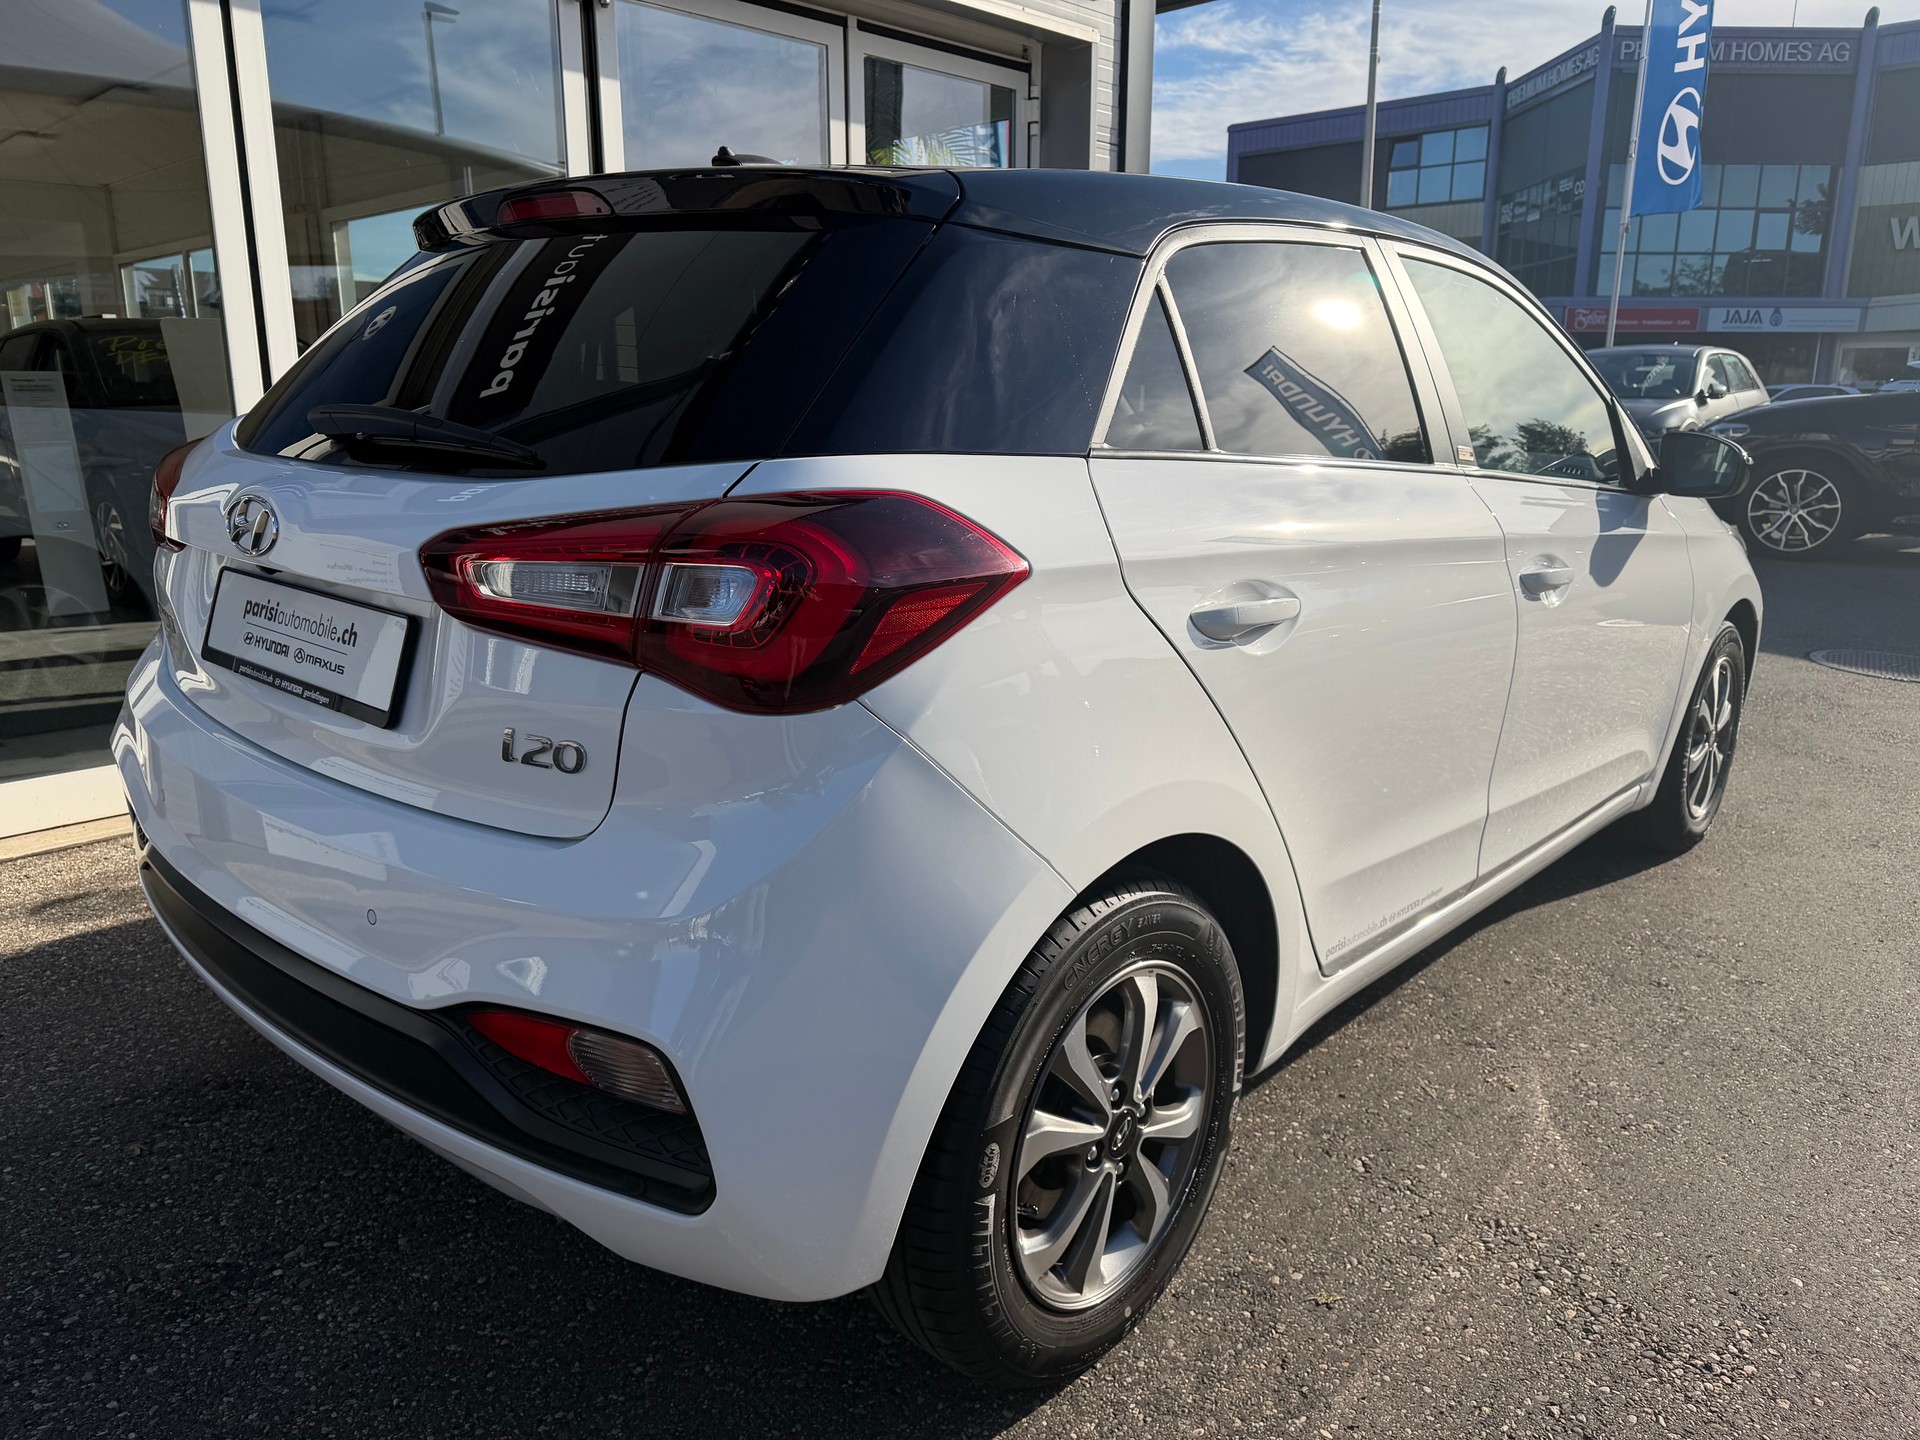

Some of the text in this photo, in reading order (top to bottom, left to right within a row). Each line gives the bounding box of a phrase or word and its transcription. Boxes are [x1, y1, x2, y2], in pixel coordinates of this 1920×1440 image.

[1730, 41, 1812, 62] HOMES
[1816, 41, 1850, 62] AG
[1507, 76, 1548, 109] PREMIUM
[1549, 55, 1583, 86] HOMES
[1584, 45, 1600, 69] AG
[1722, 309, 1763, 324] JAJA
[243, 599, 358, 648] parisiautomobile.ch
[254, 635, 345, 675] HYUNDAI MAXUS
[280, 679, 304, 695] HYUNDAI
[501, 727, 588, 775] i20
[1063, 916, 1135, 991] ENERGY
[1325, 914, 1388, 961] parisiautomobile.ch
